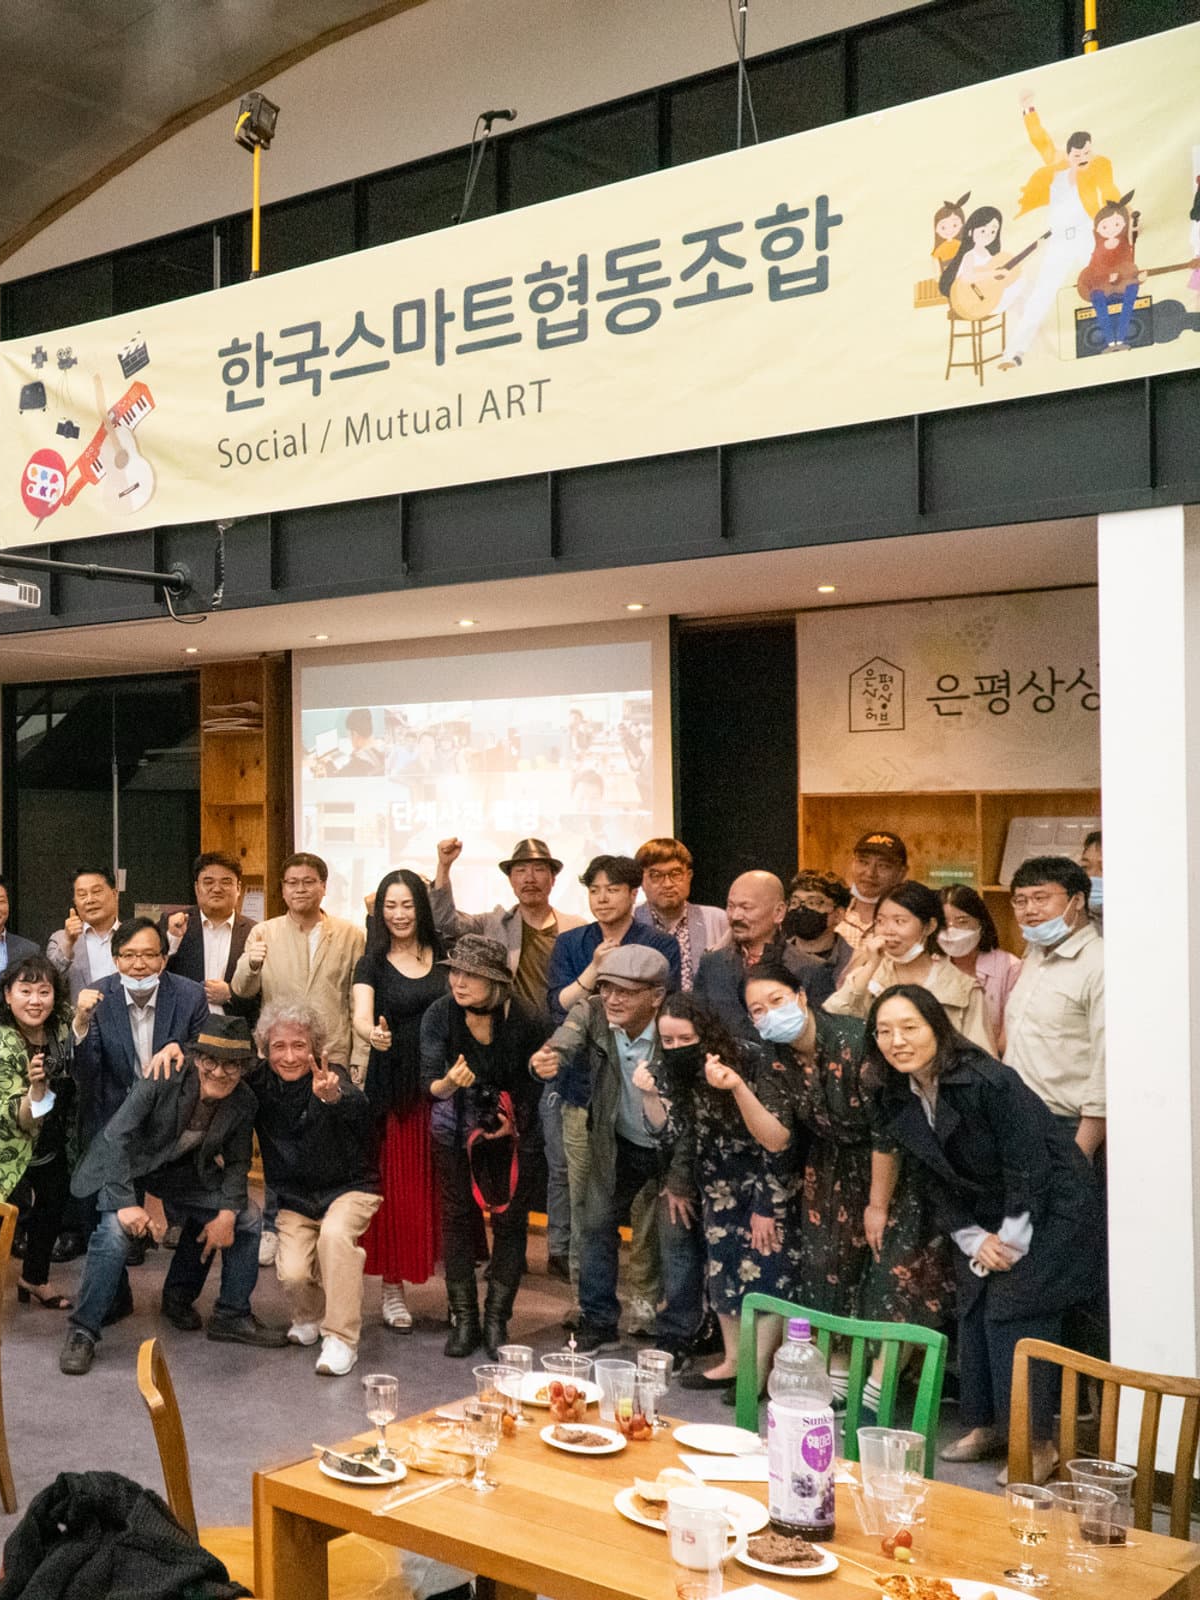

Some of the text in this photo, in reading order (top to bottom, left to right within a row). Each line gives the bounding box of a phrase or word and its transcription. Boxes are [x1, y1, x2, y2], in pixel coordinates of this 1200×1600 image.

[218, 195, 843, 412] 한국스마트협동조합
[217, 422, 307, 469] Social
[345, 393, 462, 447] Mutual
[478, 378, 551, 424] ART
